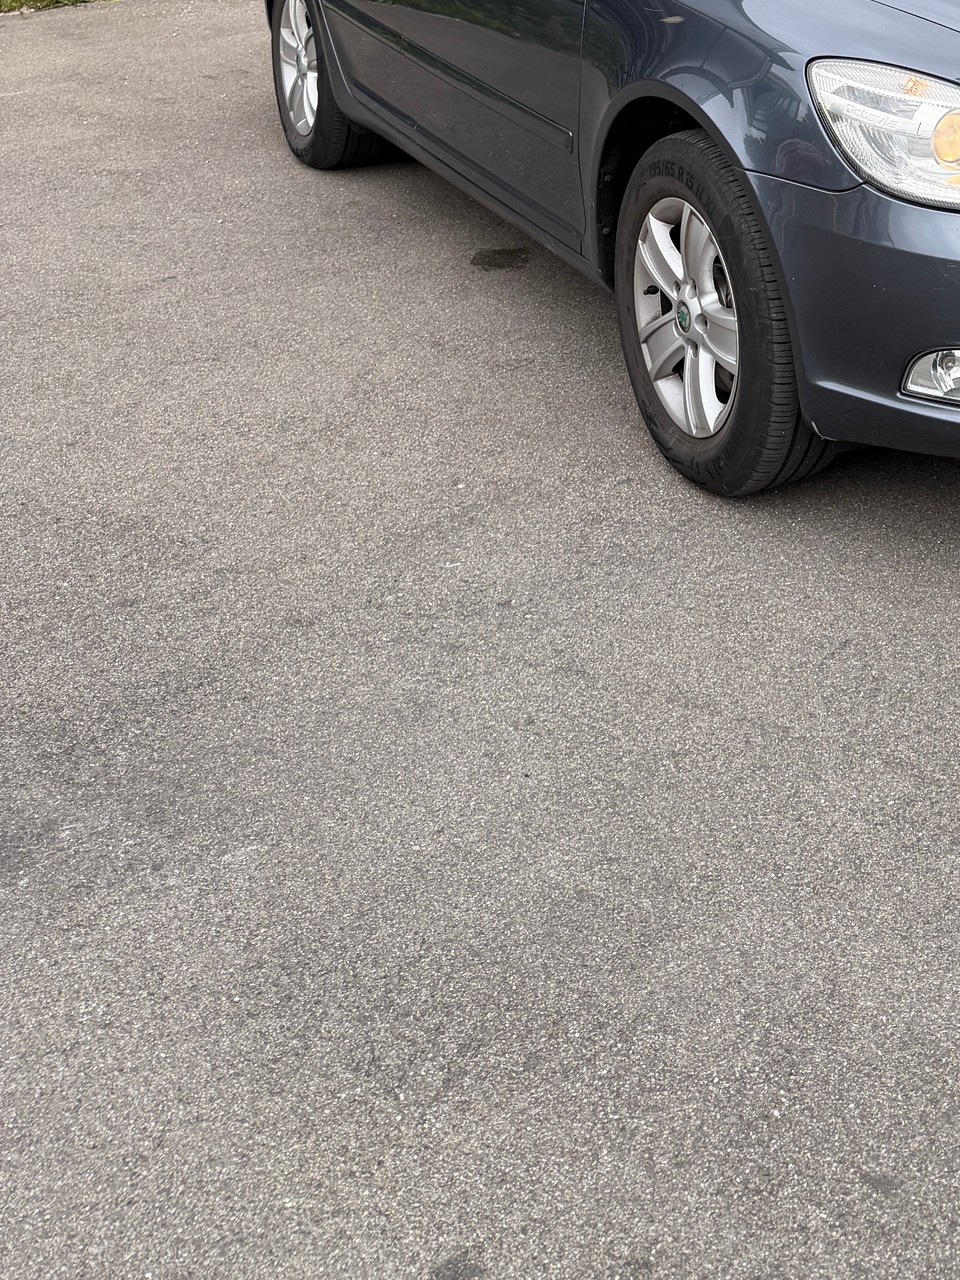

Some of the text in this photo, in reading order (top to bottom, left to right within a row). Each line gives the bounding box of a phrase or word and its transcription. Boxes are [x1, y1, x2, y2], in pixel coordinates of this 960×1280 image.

[649, 160, 676, 178] 195/65
[677, 165, 685, 183] R
[686, 172, 696, 190] 15
